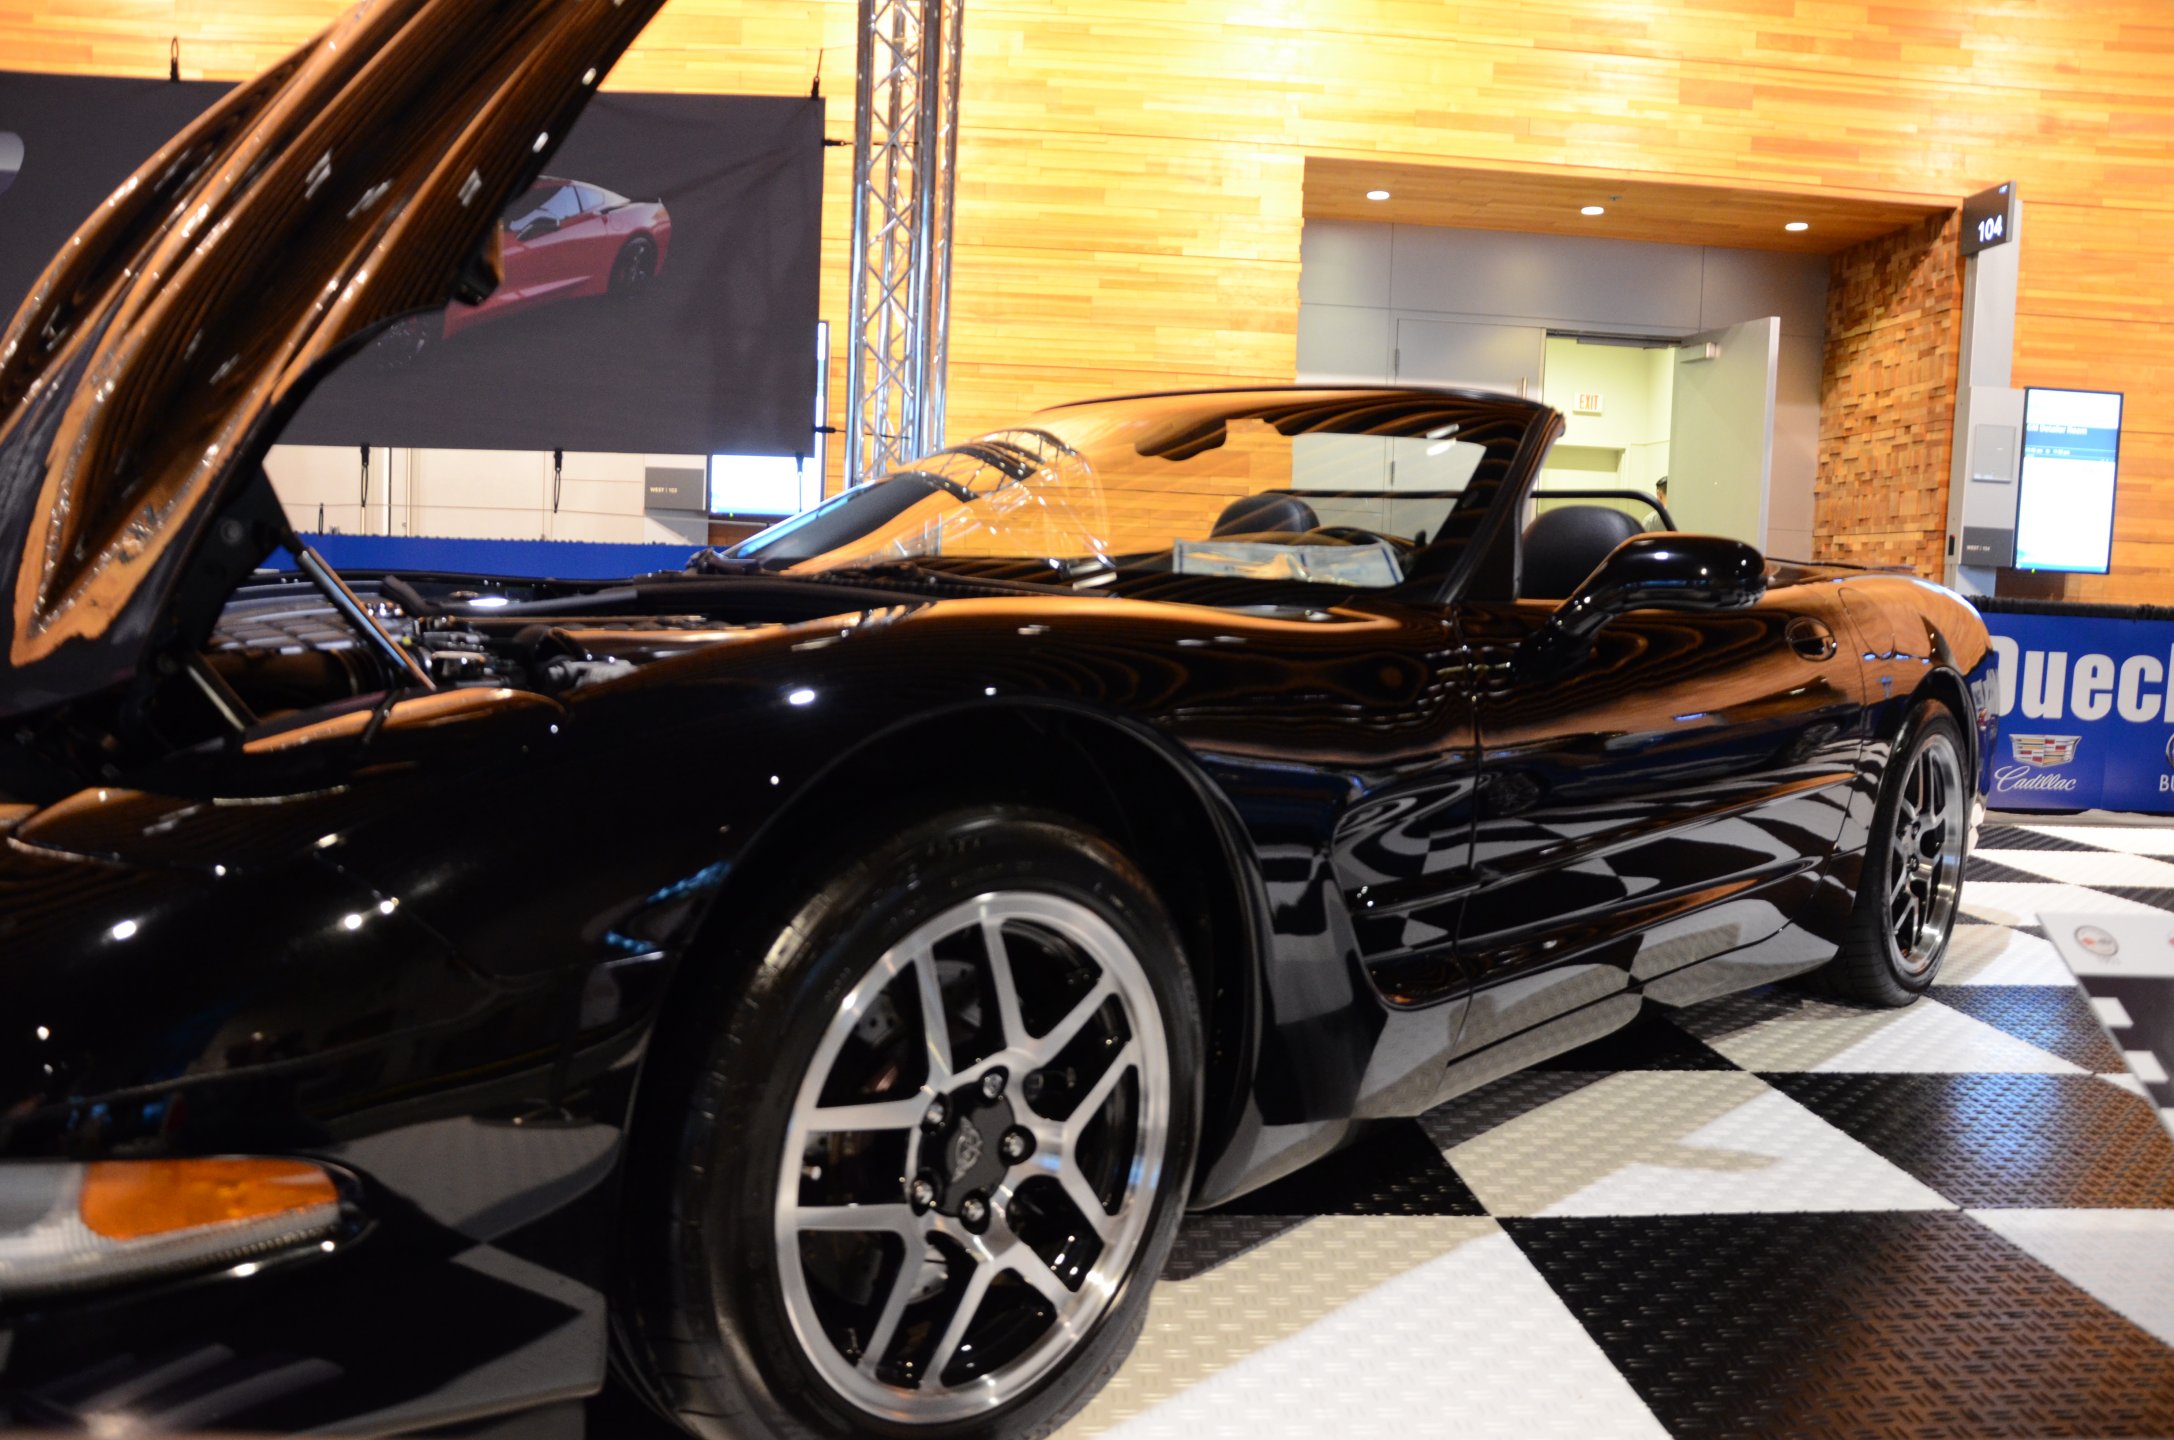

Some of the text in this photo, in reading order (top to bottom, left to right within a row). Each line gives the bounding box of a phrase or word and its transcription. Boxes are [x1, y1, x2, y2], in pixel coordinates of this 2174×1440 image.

[1978, 214, 2003, 243] 104
[1579, 393, 1599, 410] EXIT
[1988, 634, 2174, 723] Duec
[1994, 765, 2078, 792] Cadillac
